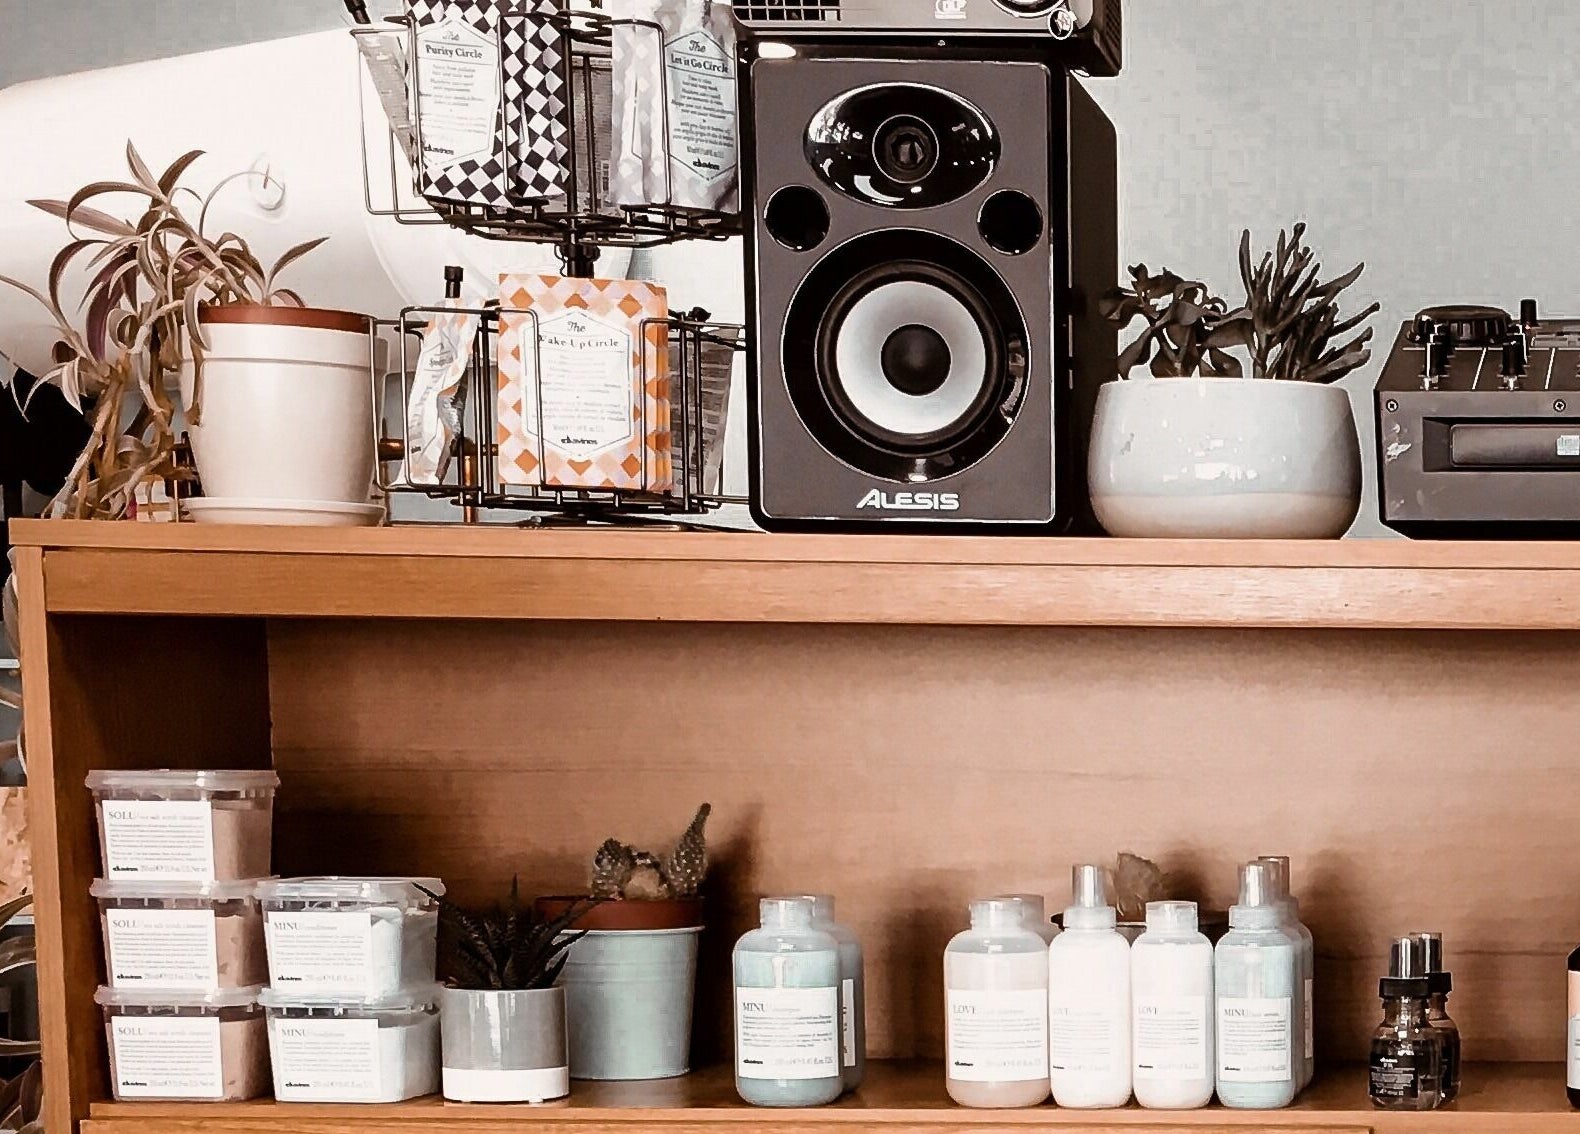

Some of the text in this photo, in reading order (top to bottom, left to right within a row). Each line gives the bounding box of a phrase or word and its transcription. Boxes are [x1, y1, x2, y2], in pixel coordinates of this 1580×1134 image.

[426, 44, 483, 59] Purity Circle
[703, 60, 729, 74] Circle
[856, 488, 960, 510] ALESIS
